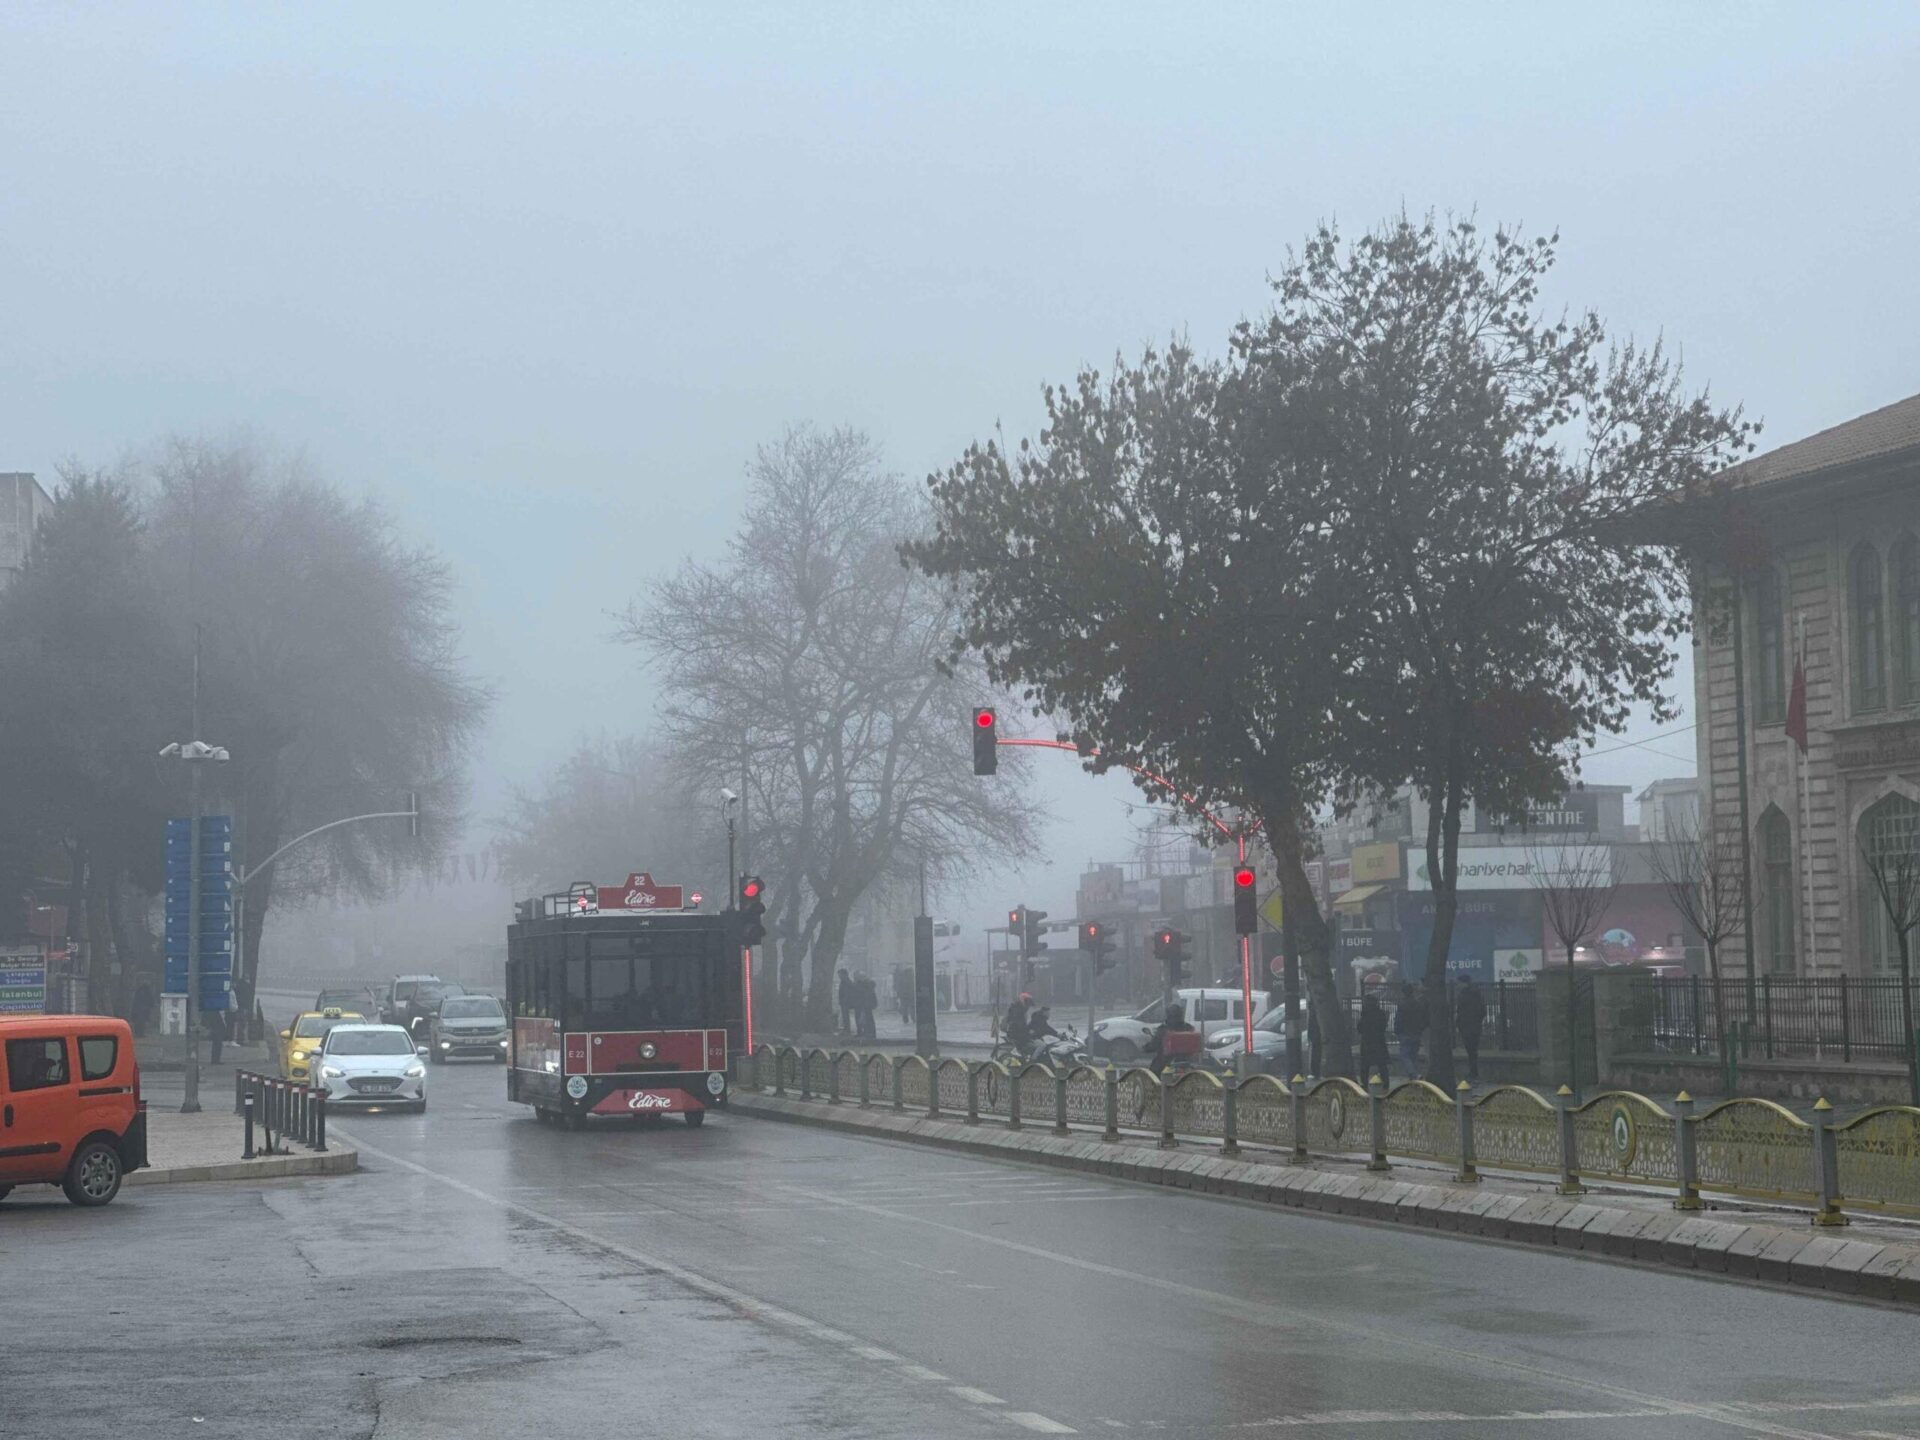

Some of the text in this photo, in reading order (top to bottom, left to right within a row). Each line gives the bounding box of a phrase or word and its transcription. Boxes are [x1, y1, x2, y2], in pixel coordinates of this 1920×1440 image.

[634, 876, 646, 886] 22
[624, 889, 656, 904] Edirne
[1346, 936, 1373, 947] BÜFE
[1458, 957, 1482, 969] BÜFE
[576, 1050, 585, 1058] 22
[628, 1091, 672, 1109] Edirne
